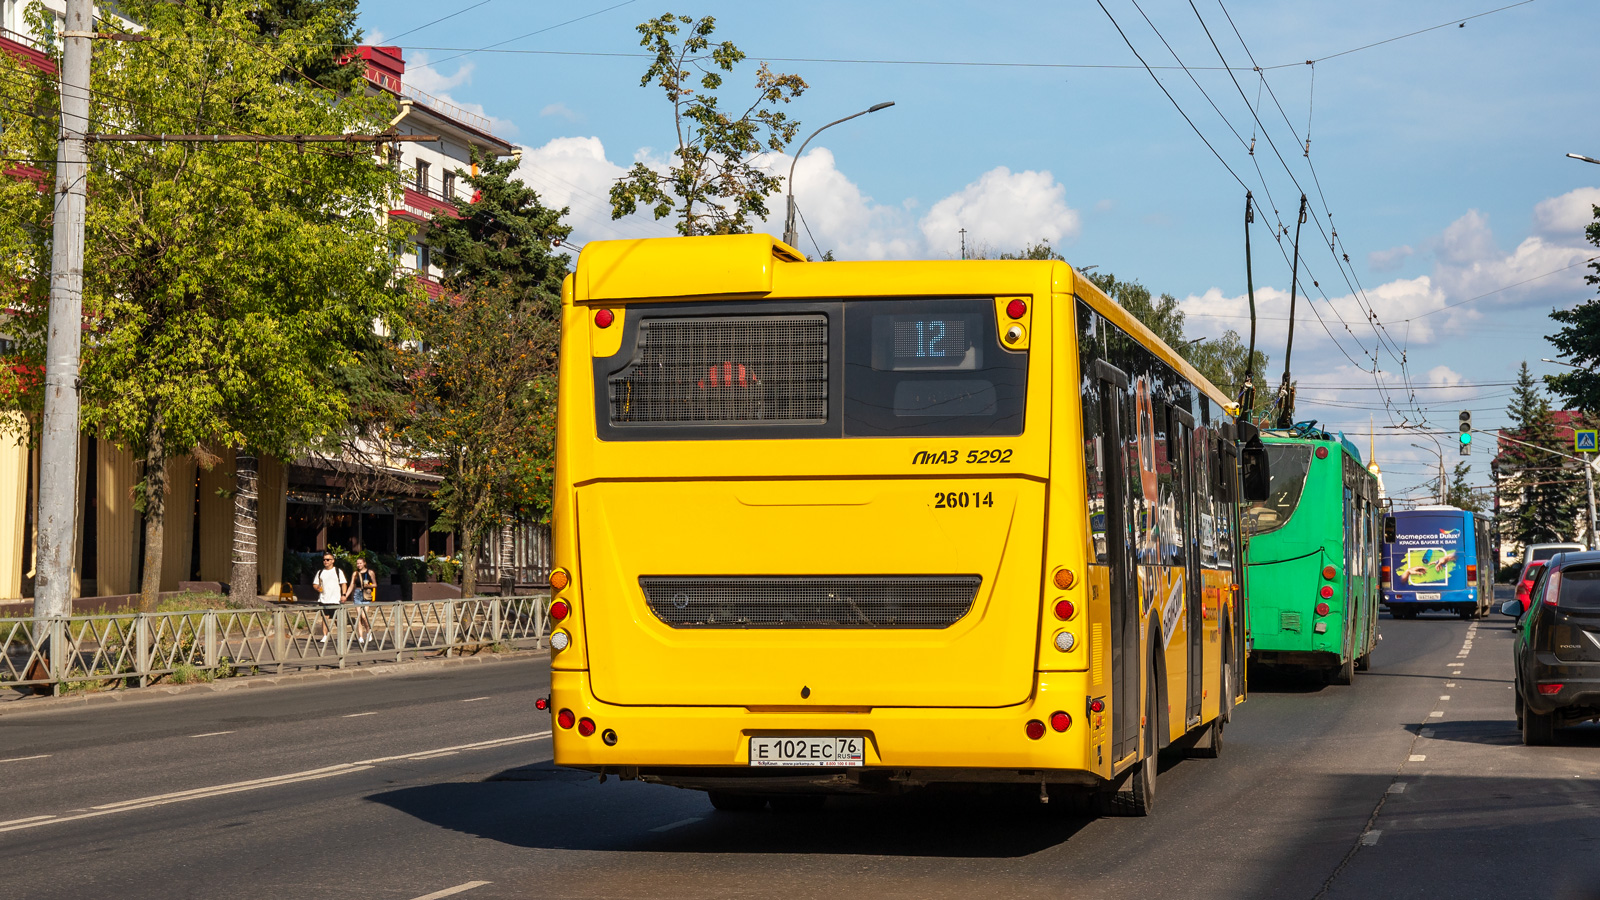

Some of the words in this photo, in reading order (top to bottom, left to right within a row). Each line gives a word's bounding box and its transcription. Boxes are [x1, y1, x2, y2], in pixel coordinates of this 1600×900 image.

[915, 320, 945, 357] 12
[911, 449, 960, 465] ЛиАЗ
[965, 448, 1014, 464] 5292
[934, 491, 994, 509] 26014
[838, 739, 857, 753] 76
